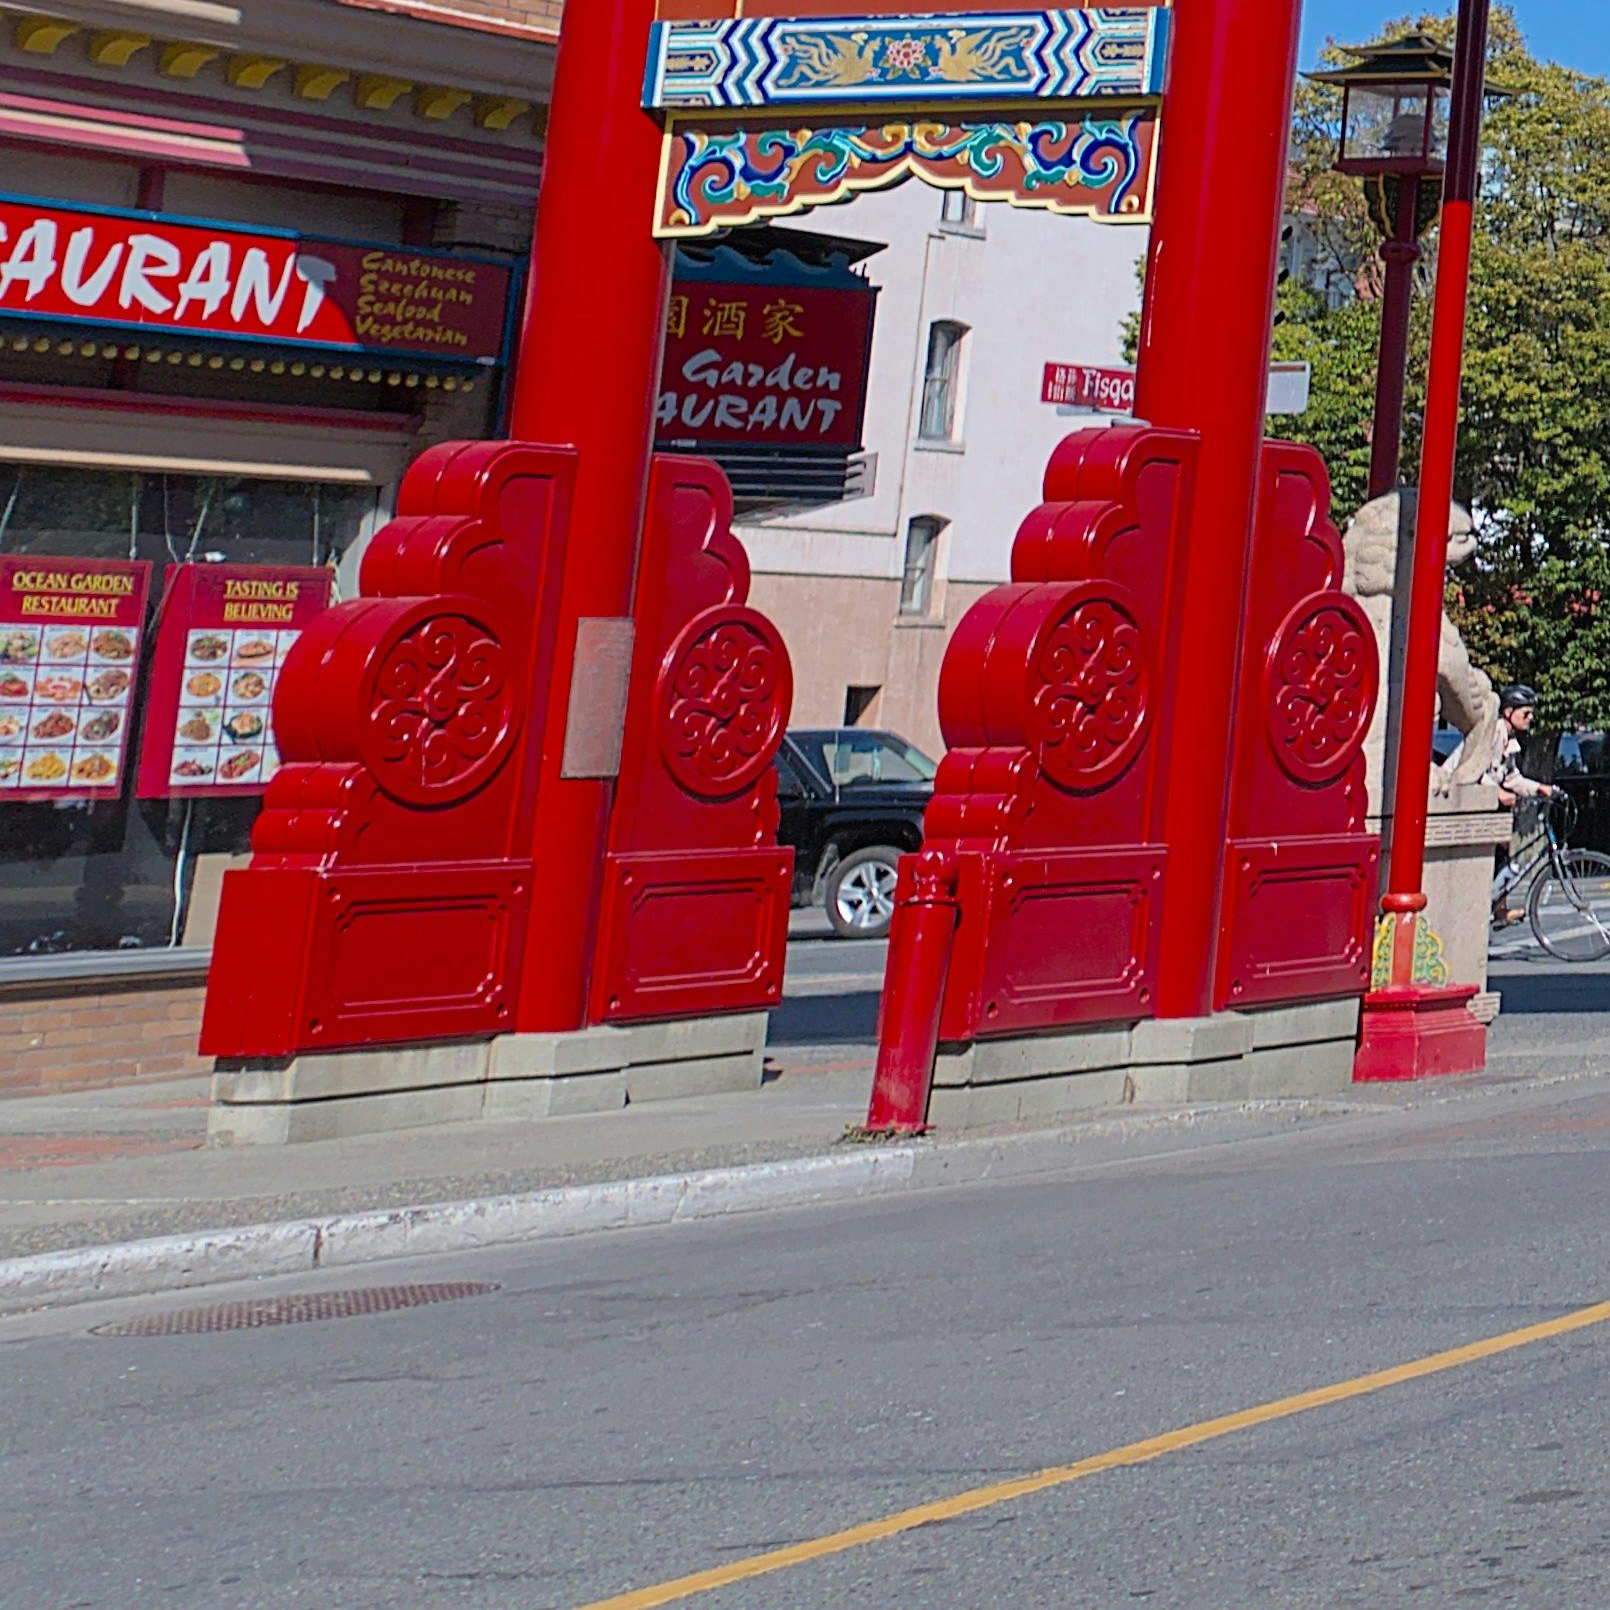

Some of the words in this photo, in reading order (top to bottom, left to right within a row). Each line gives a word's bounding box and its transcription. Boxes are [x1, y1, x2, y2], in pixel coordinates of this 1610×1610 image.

[0, 218, 337, 335] AURANT
[362, 251, 476, 283] Cantonese
[357, 294, 443, 323] Seafood
[355, 314, 468, 347] Vegetarian
[681, 348, 842, 391] Garden
[12, 570, 67, 590] OCEAN
[70, 573, 133, 593] GARDEN
[225, 579, 283, 598] TASTING
[285, 581, 298, 599] IS
[22, 596, 119, 615] RESTAURANT
[224, 602, 293, 619] BELIEVING
